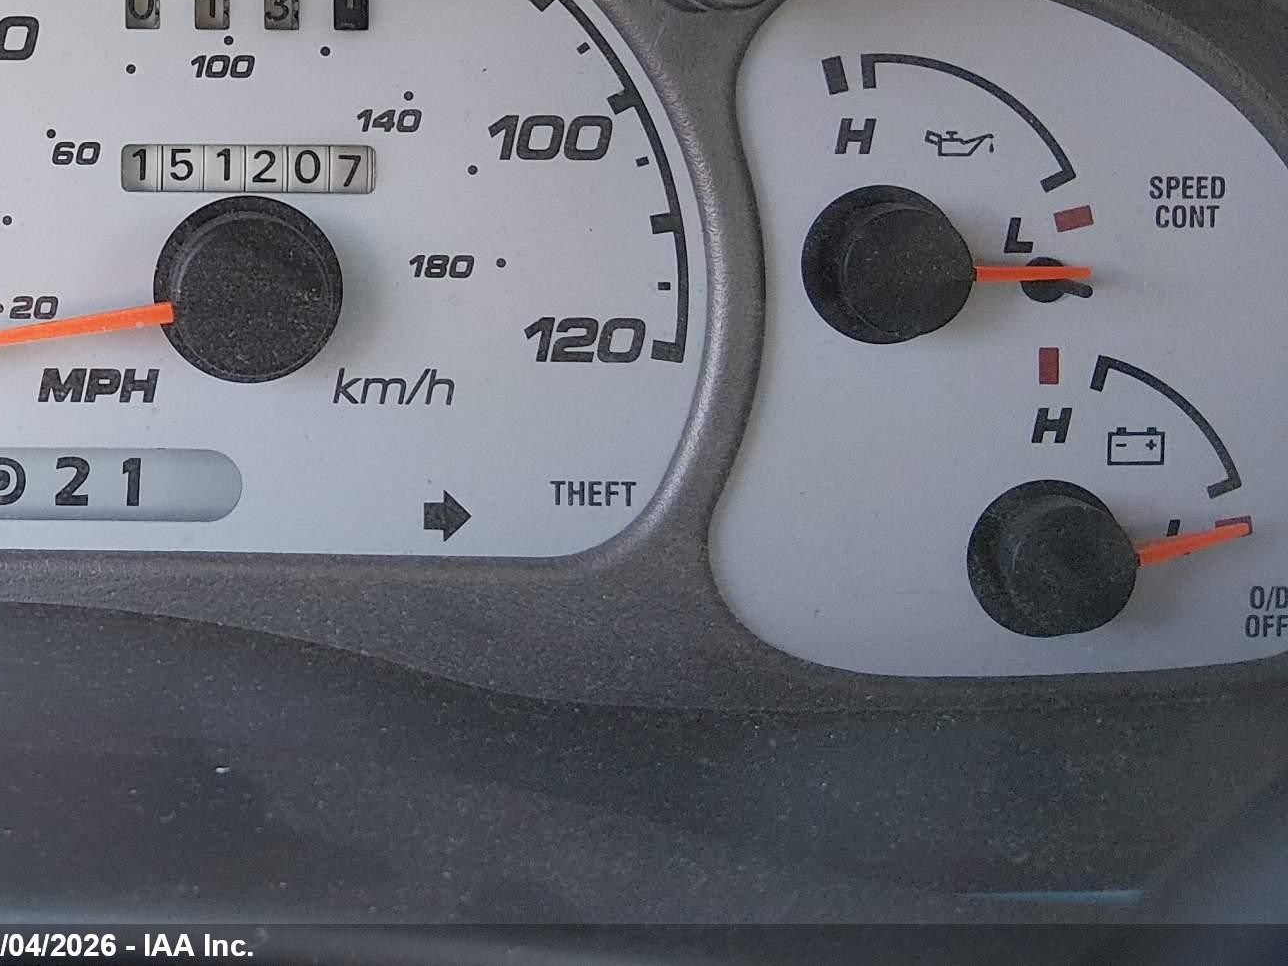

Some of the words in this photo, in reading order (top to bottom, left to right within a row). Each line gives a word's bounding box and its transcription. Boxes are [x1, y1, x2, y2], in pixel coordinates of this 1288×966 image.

[191, 55, 255, 78] 100
[357, 109, 422, 132] 140
[487, 114, 613, 161] 100
[835, 118, 876, 154] H
[51, 141, 101, 165] 60
[131, 147, 363, 188] 151207
[1150, 176, 1225, 199] SPEED
[1156, 205, 1219, 228] CONT
[1003, 217, 1033, 254] L
[409, 255, 474, 278] 180
[10, 296, 58, 319] 20
[524, 317, 646, 363] 120
[38, 368, 160, 403] MPH
[333, 368, 454, 405] km/h
[1031, 408, 1072, 443] H
[55, 457, 90, 506] 2
[123, 458, 141, 506] 1
[550, 481, 636, 506] THEFT
[1245, 615, 1288, 637] OFF
